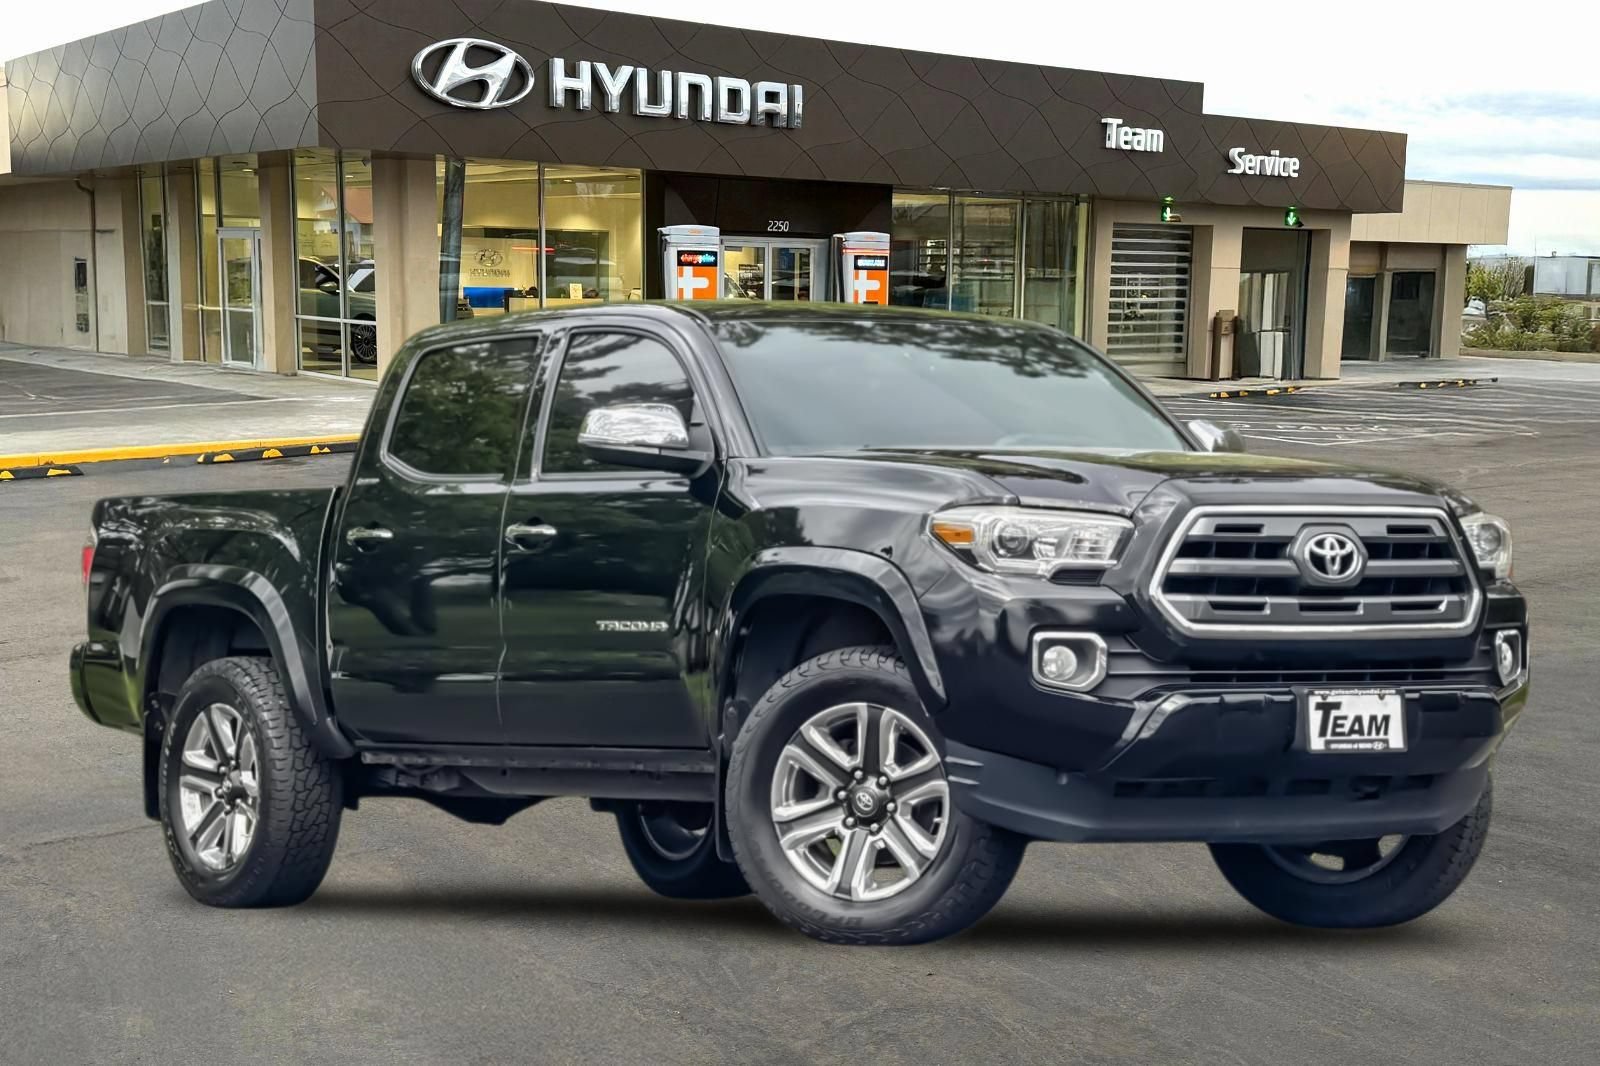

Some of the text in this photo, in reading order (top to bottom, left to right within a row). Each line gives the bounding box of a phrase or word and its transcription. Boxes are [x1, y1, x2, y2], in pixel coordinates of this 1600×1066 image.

[549, 57, 803, 129] HYUNDAI
[1102, 117, 1164, 153] Team
[1227, 147, 1300, 178] Service
[767, 220, 790, 232] 2250
[595, 620, 669, 632] TACOMA
[1314, 701, 1391, 738] TEAM
